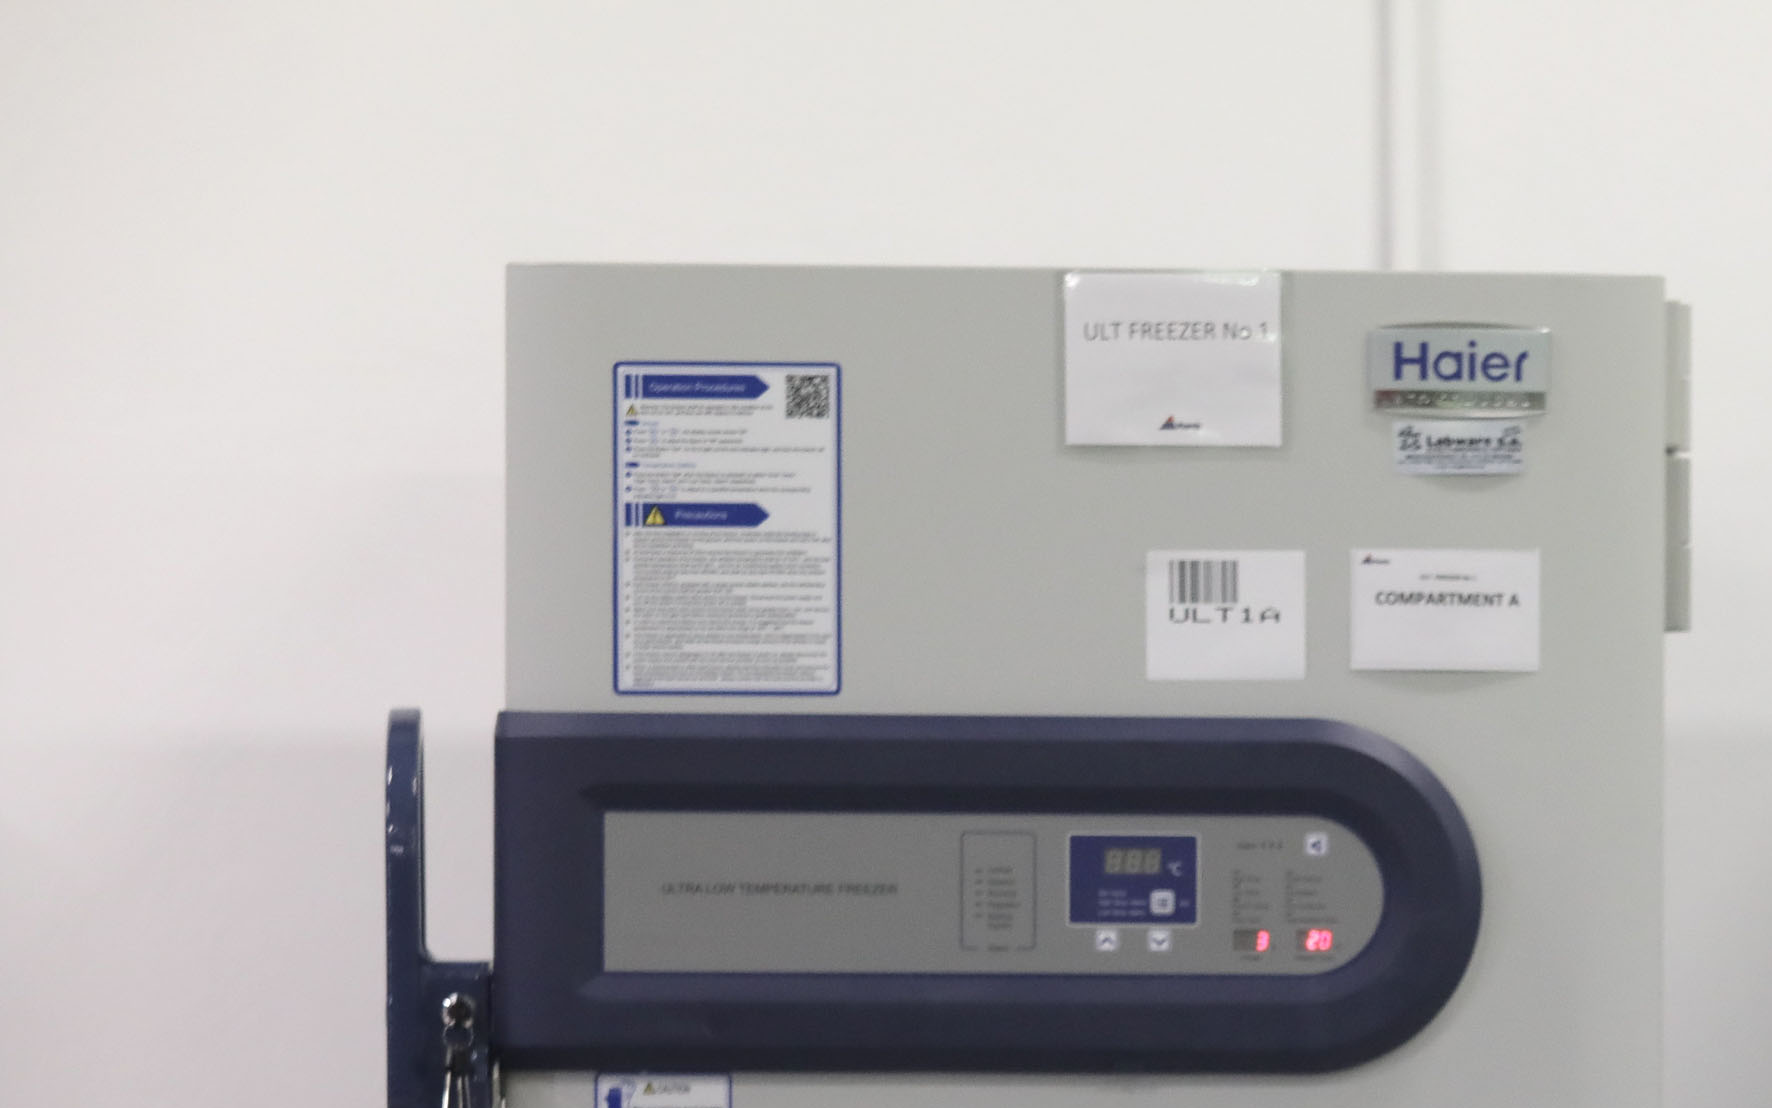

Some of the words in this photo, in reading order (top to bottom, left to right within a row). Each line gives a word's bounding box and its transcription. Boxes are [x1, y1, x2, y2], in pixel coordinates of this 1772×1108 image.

[1083, 320, 1122, 342] ULT
[1128, 321, 1217, 341] FREEZER
[1222, 322, 1252, 341] No
[1258, 321, 1270, 341] 1
[1393, 340, 1529, 383] Haier
[1374, 591, 1505, 607] COMPARTMENT
[1508, 593, 1520, 607] A
[1168, 606, 1281, 624] ULT1A
